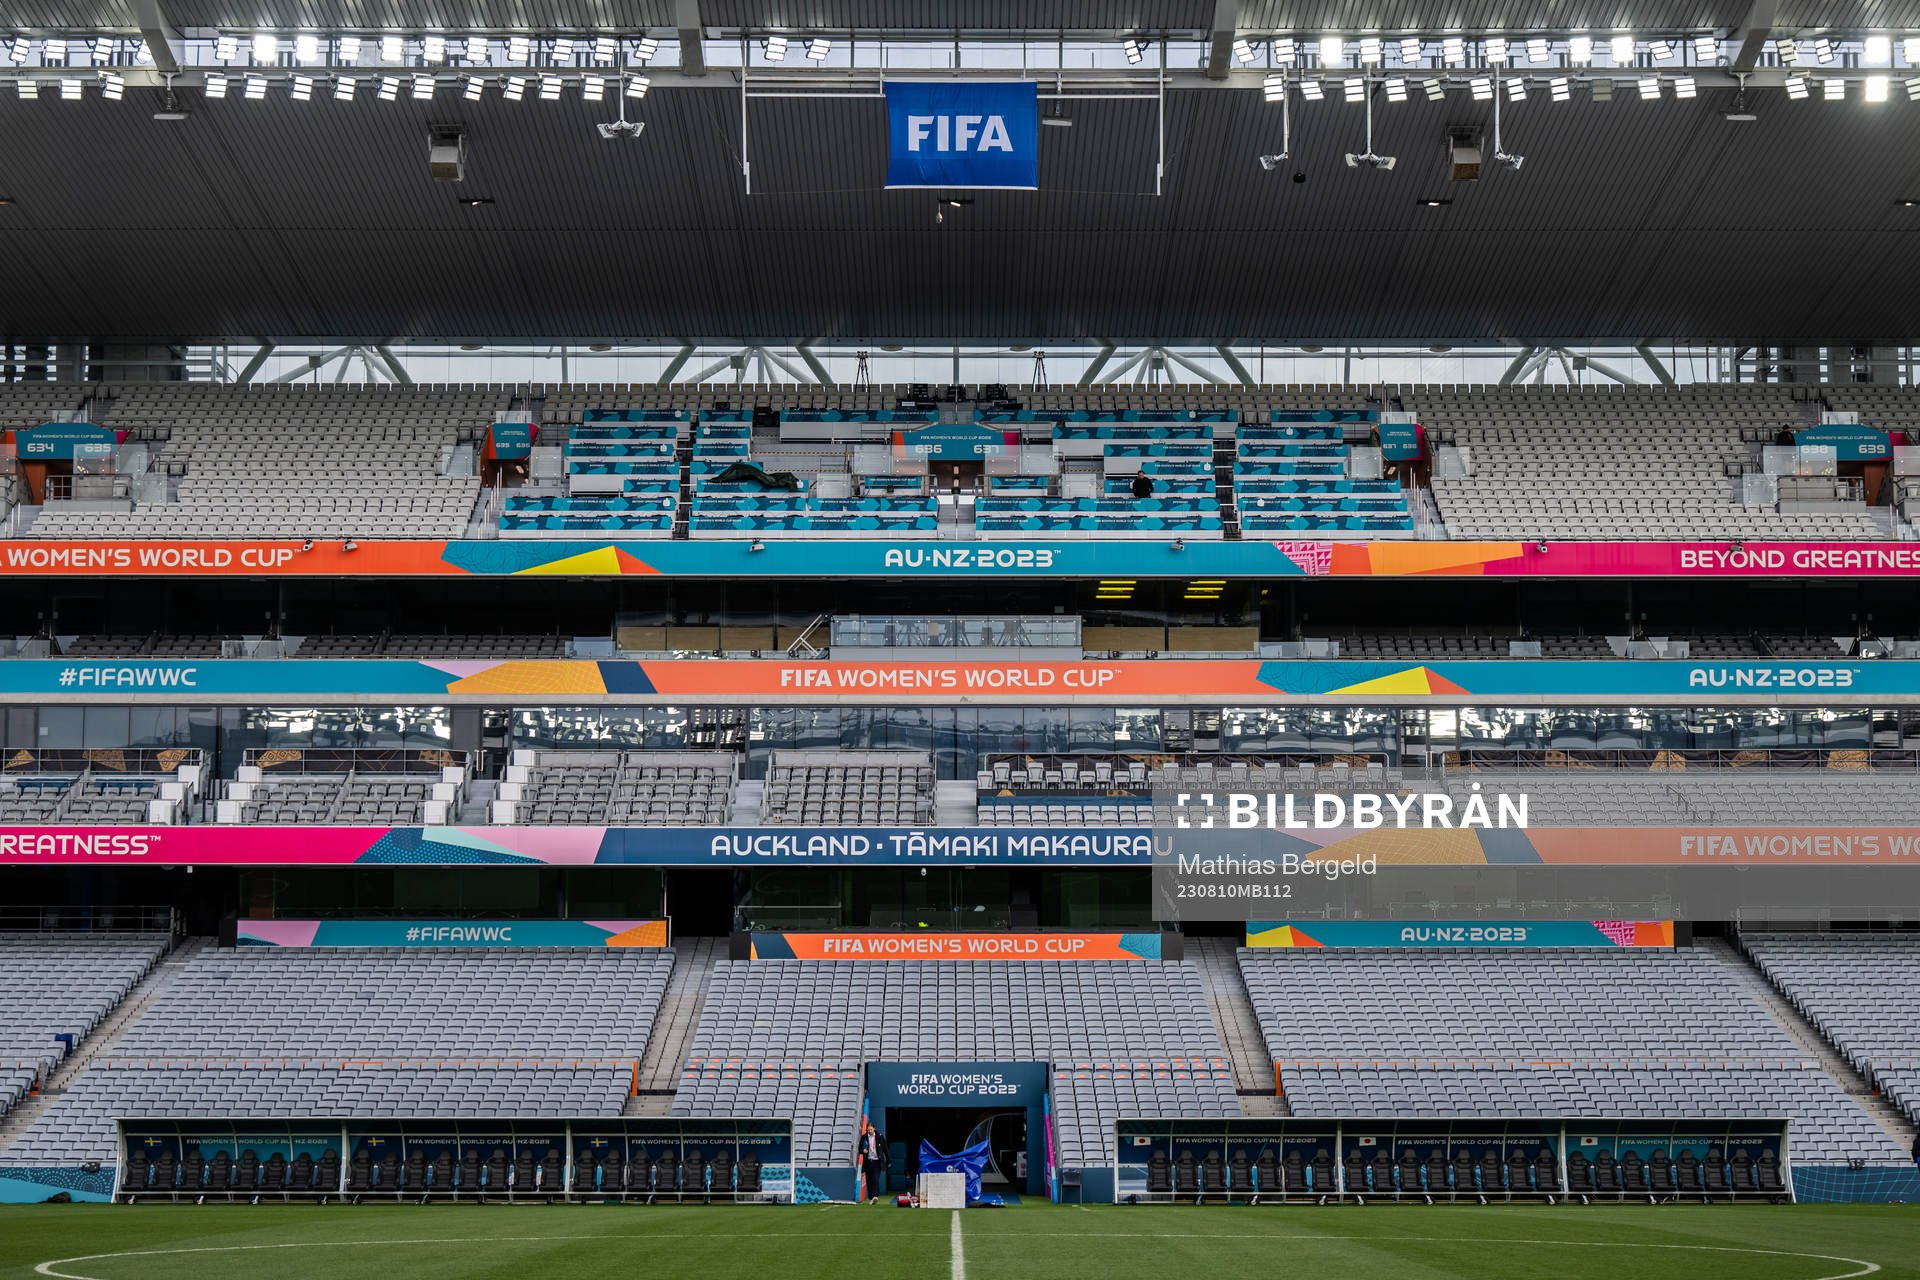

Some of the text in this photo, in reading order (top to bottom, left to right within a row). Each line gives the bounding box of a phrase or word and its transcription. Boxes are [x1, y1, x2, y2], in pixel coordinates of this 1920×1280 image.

[908, 115, 1013, 152] FIFA
[27, 443, 55, 452] 634
[1858, 444, 1886, 454] 639
[7, 548, 131, 567] WOMEN'S
[139, 548, 232, 567] WORLD
[1681, 550, 1785, 568] BEYOND
[59, 668, 197, 686] #FIFAWWC
[780, 669, 832, 687] FIFA
[837, 668, 957, 688] WOMEN'S
[964, 668, 1055, 688] WORLD
[711, 831, 1173, 857] AUCKLAND TĀMAKI MAKAURAU
[1680, 835, 1739, 856] FIFA
[1744, 835, 1880, 856] WOMEN'S
[406, 927, 512, 941] #FIFAWWC
[823, 938, 864, 953] FIFA
[868, 938, 962, 953] WOMEN'S
[967, 938, 1039, 953] WORLD
[911, 1073, 1003, 1084] FIFA WOMEN'S
[897, 1084, 944, 1095] WORLD
[949, 1084, 975, 1095] CUP
